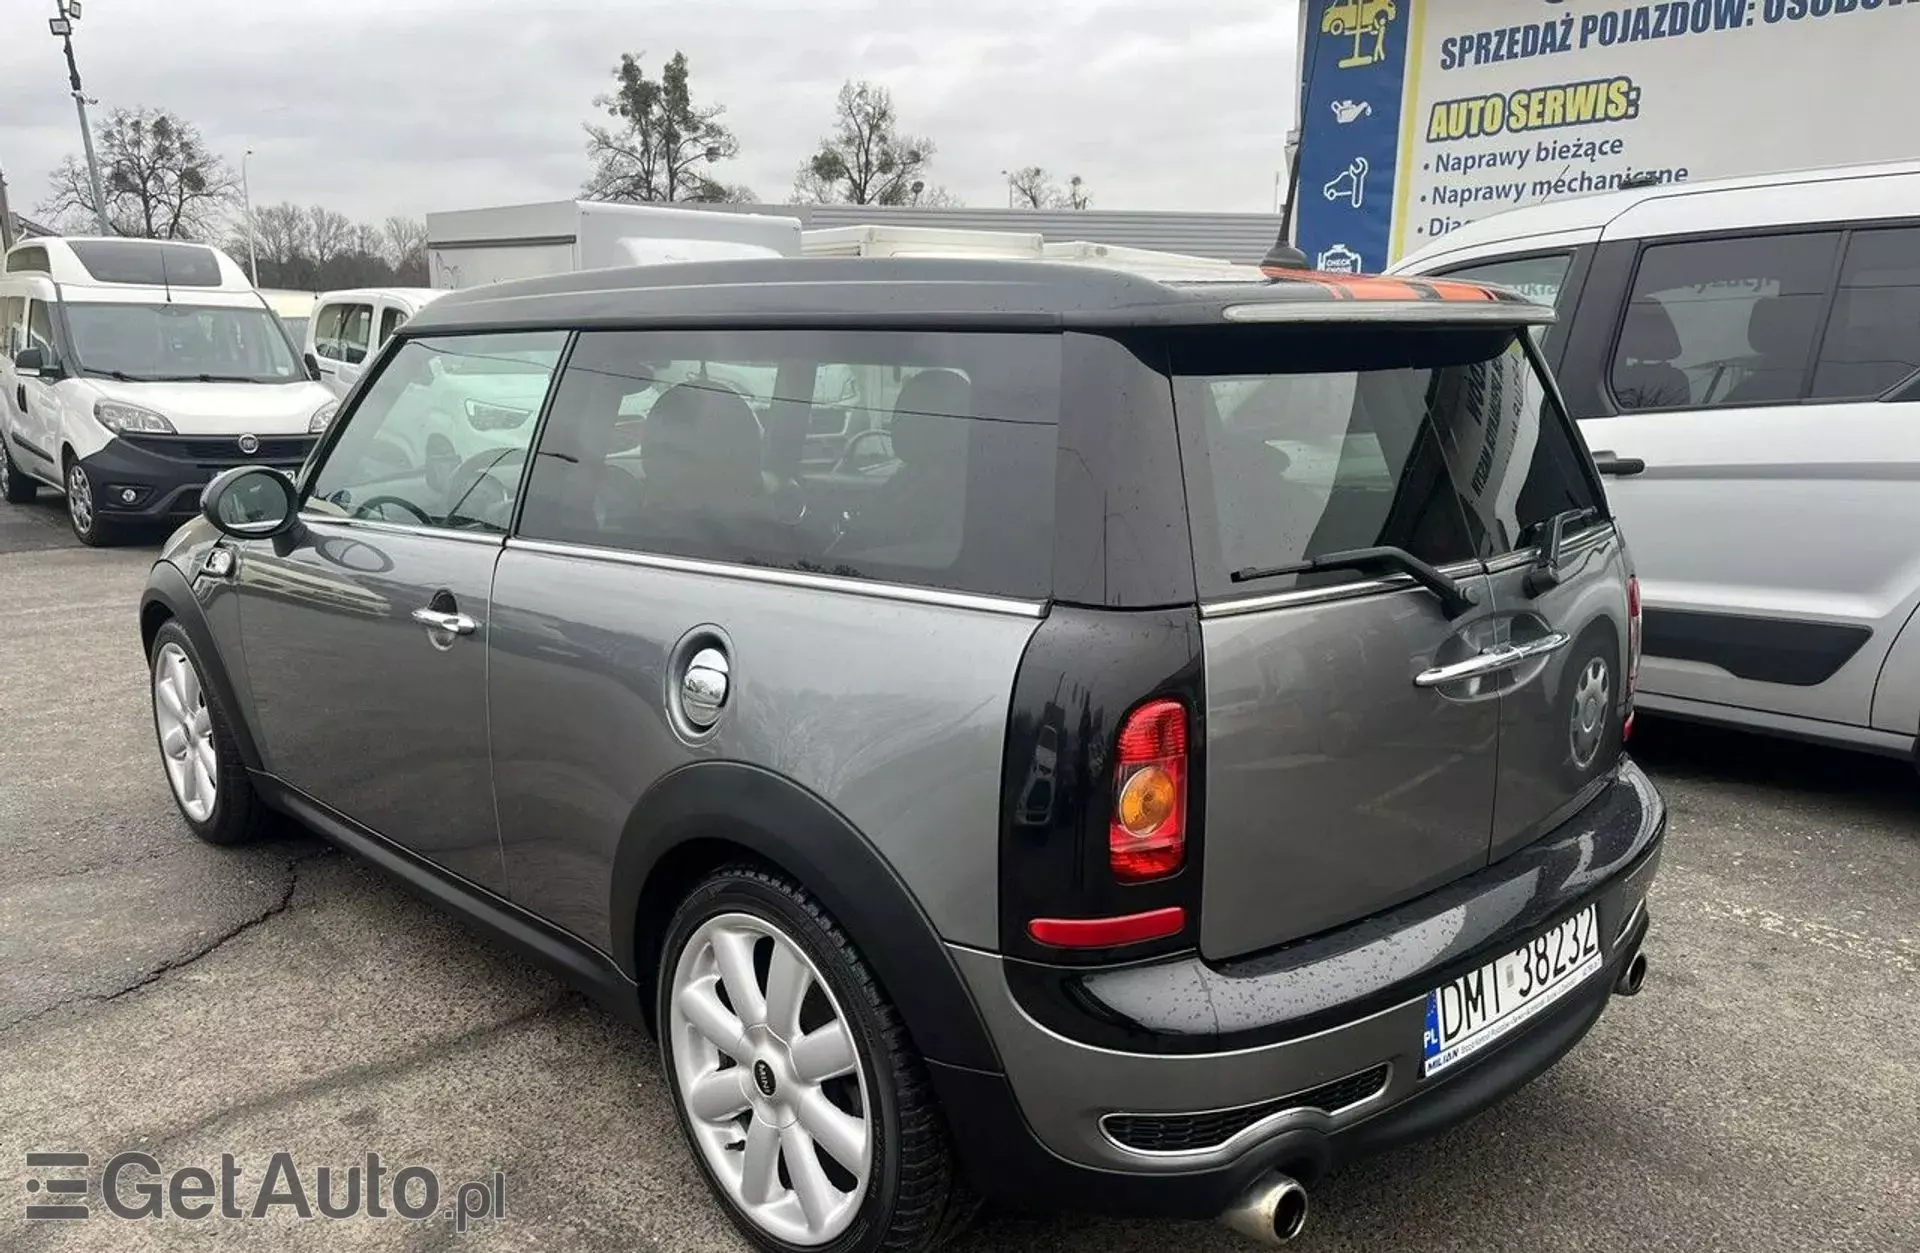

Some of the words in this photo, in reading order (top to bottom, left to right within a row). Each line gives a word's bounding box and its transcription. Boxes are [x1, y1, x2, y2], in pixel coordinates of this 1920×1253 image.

[1441, 12, 1574, 70] SPRZEDAŻ
[1427, 93, 1506, 143] AUTO
[1507, 76, 1641, 133] SERWIS:
[1435, 146, 1530, 175] Naprawy
[1535, 137, 1623, 162] bieżące
[1432, 179, 1526, 207] Naprawy
[1440, 963, 1500, 1043] DMI
[1515, 906, 1596, 998] 38232
[1424, 1028, 1438, 1048] PL
